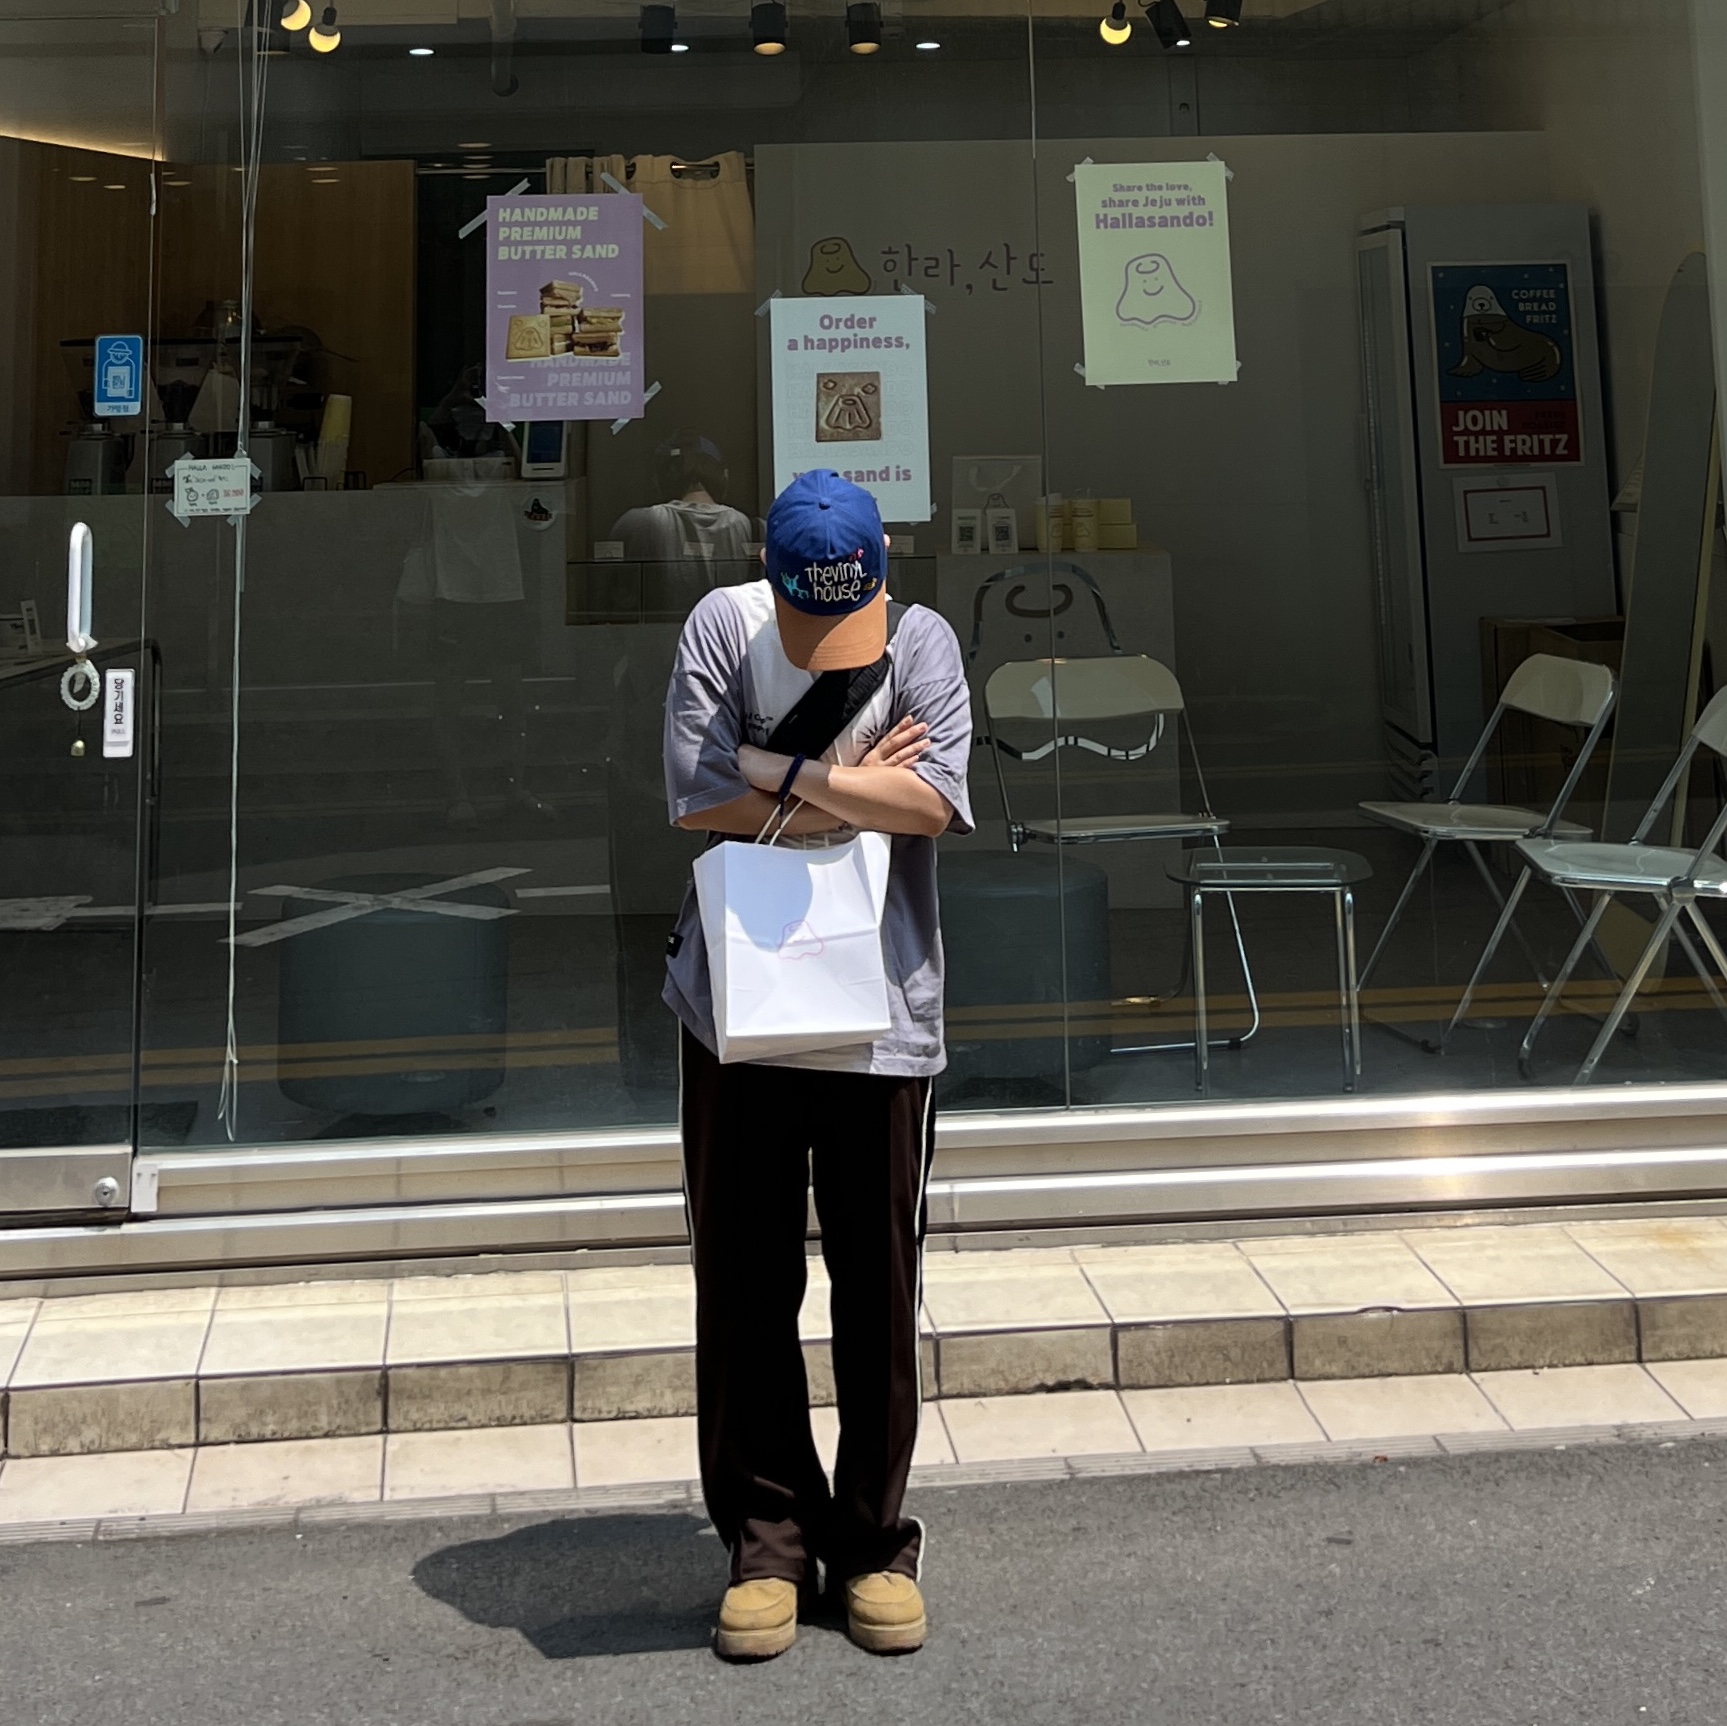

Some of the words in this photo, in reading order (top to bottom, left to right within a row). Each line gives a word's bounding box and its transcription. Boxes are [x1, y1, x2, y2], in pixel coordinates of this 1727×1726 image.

[1112, 183, 1143, 193] Share
[1145, 182, 1163, 192] the
[1165, 182, 1193, 192] love,
[1101, 197, 1140, 208] share
[1143, 196, 1172, 209] Jeju
[1175, 195, 1206, 207] with
[498, 206, 599, 222] HANDMADE
[1095, 211, 1214, 230] Hallasando!
[498, 226, 582, 241] PREMIUM
[497, 245, 567, 261] BUTTER
[571, 244, 620, 260] SAND
[1511, 289, 1557, 300] COFFEE
[1518, 302, 1558, 312] BREAD
[819, 313, 877, 331] Order
[1526, 314, 1558, 324] FRITZ
[787, 338, 798, 351] a
[803, 333, 911, 353] happiness,
[547, 371, 632, 388] PREMIUM
[508, 392, 579, 408] BUTTER
[583, 391, 632, 406] SAND
[1452, 410, 1509, 432] JOIN
[1453, 435, 1498, 457] THE
[1503, 434, 1569, 456] FRITZ
[842, 466, 890, 483] sand
[895, 465, 912, 481] is
[813, 579, 861, 603] house
[113, 678, 125, 725] 당기세요
